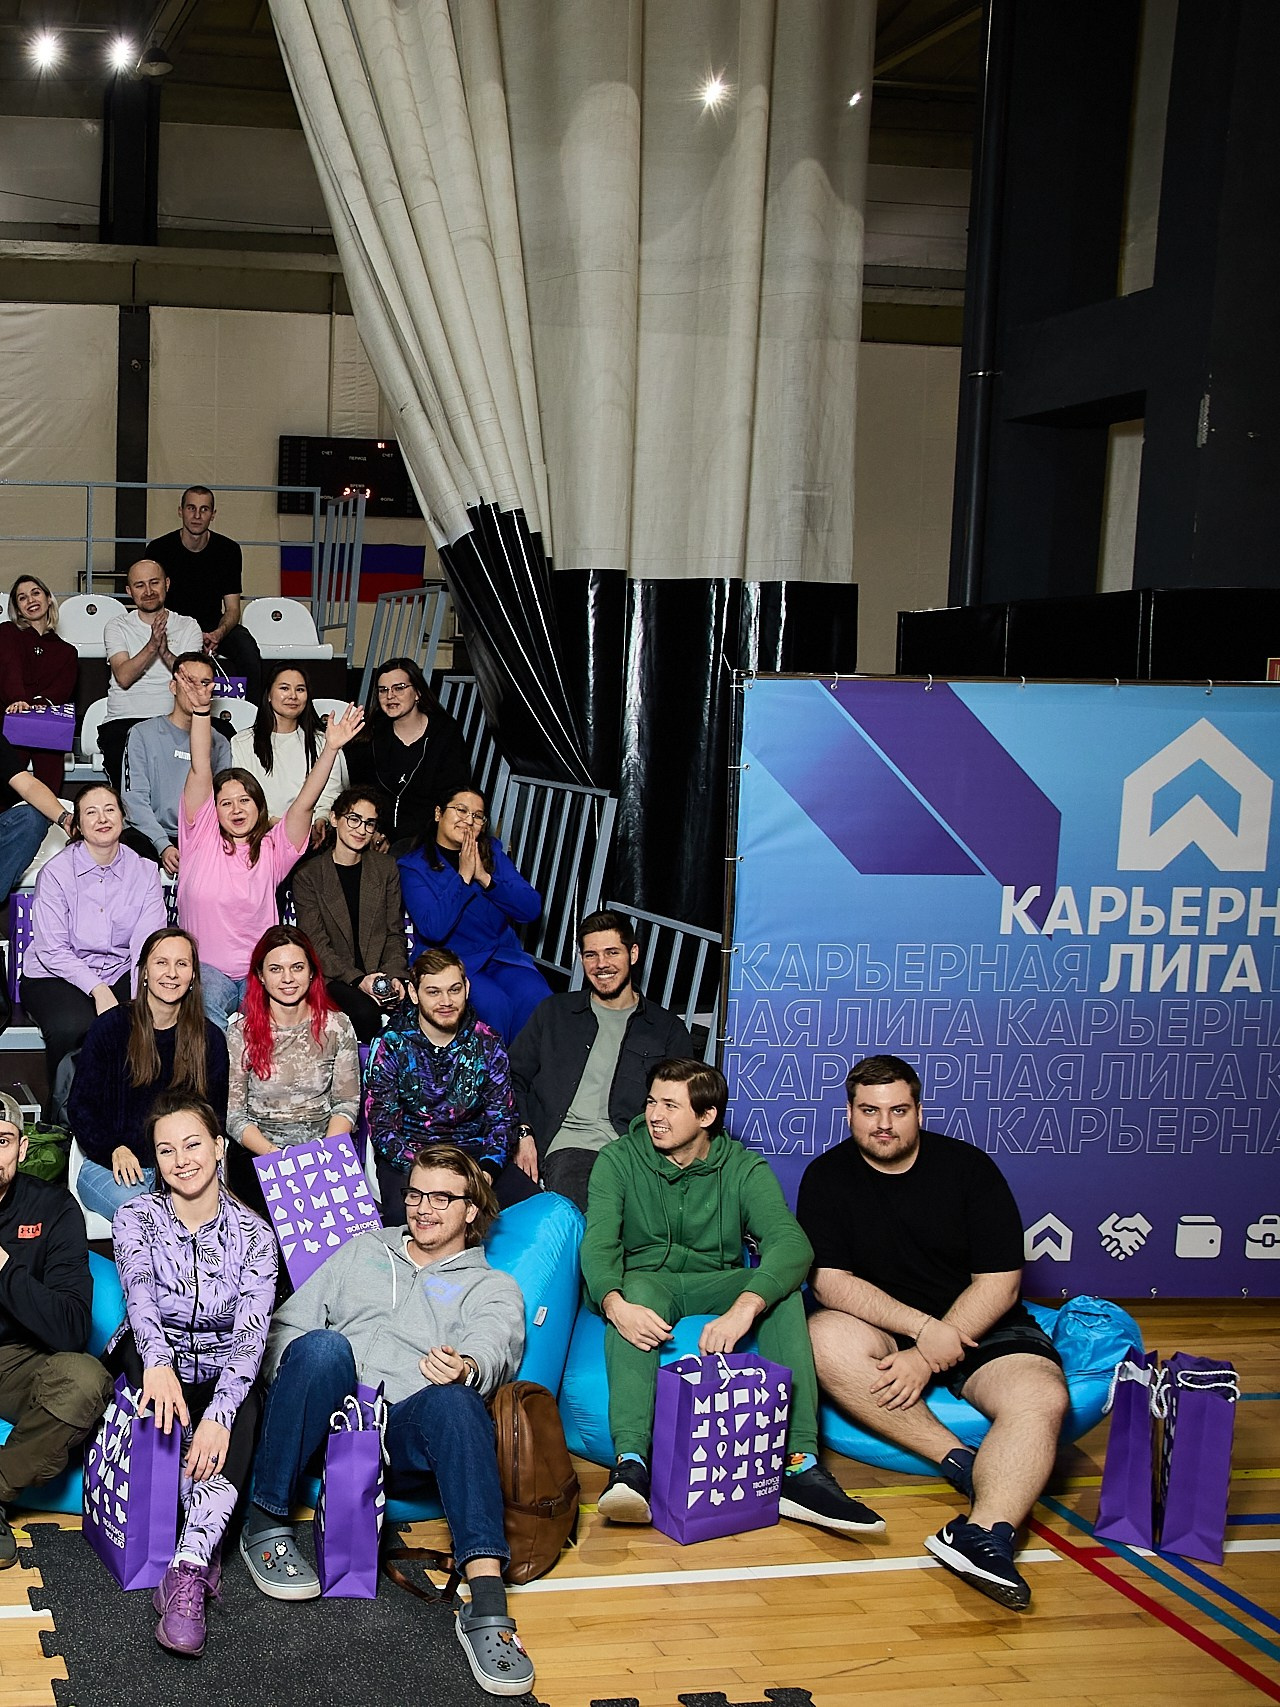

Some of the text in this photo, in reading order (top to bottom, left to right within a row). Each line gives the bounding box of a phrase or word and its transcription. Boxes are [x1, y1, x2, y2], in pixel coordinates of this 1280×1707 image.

[174, 749, 191, 761] PUM
[730, 942, 1091, 992] КАРЬЕРНАЯ
[1099, 943, 1263, 993] ЛИГА
[827, 998, 984, 1046] ЛИГА
[996, 998, 1280, 1046] КАРЬЕРН
[728, 1053, 1084, 1101] КАРРНАЯ
[1091, 1053, 1247, 1100] ЛИГА
